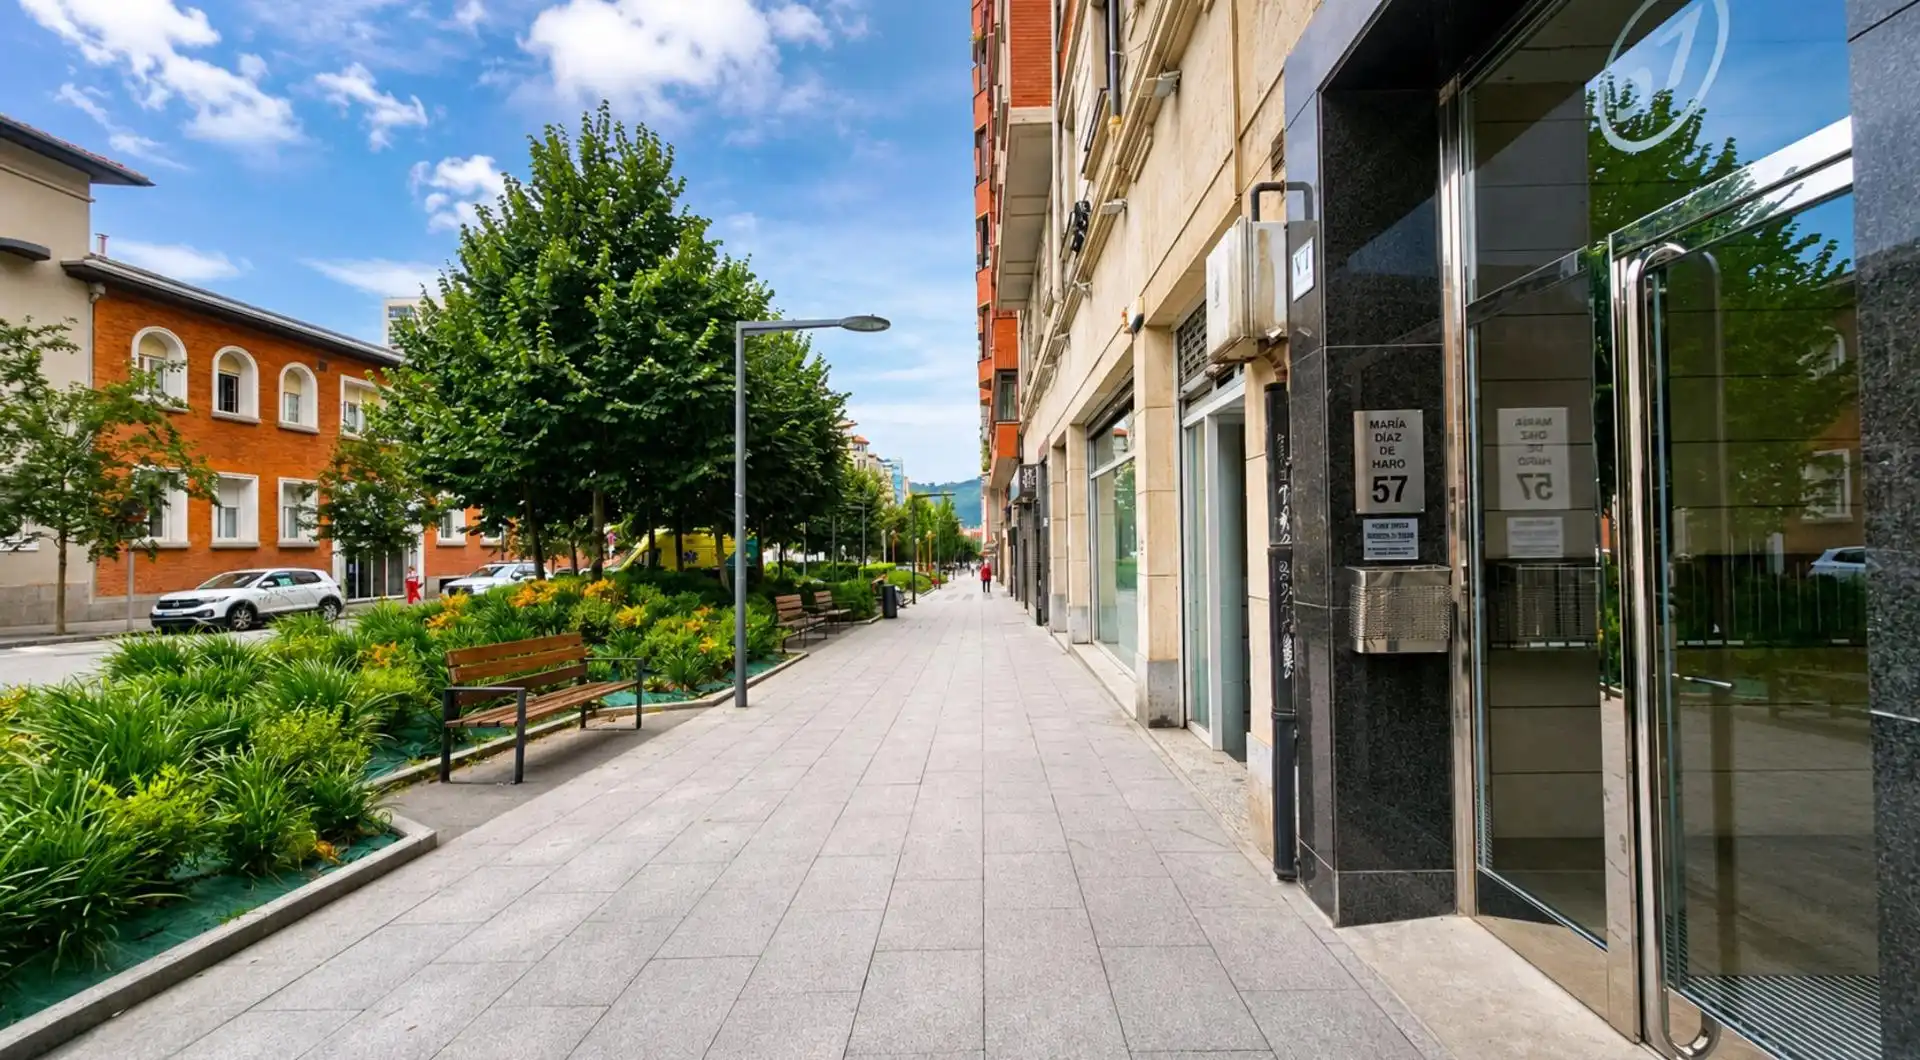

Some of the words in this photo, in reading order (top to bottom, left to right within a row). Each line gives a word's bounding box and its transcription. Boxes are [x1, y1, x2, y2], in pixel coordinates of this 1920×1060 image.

[1369, 417, 1407, 430] MARÍA
[1375, 432, 1402, 443] DÍAZ
[1380, 446, 1396, 456] DE
[1372, 459, 1406, 470] HARO
[1372, 475, 1408, 504] 57
